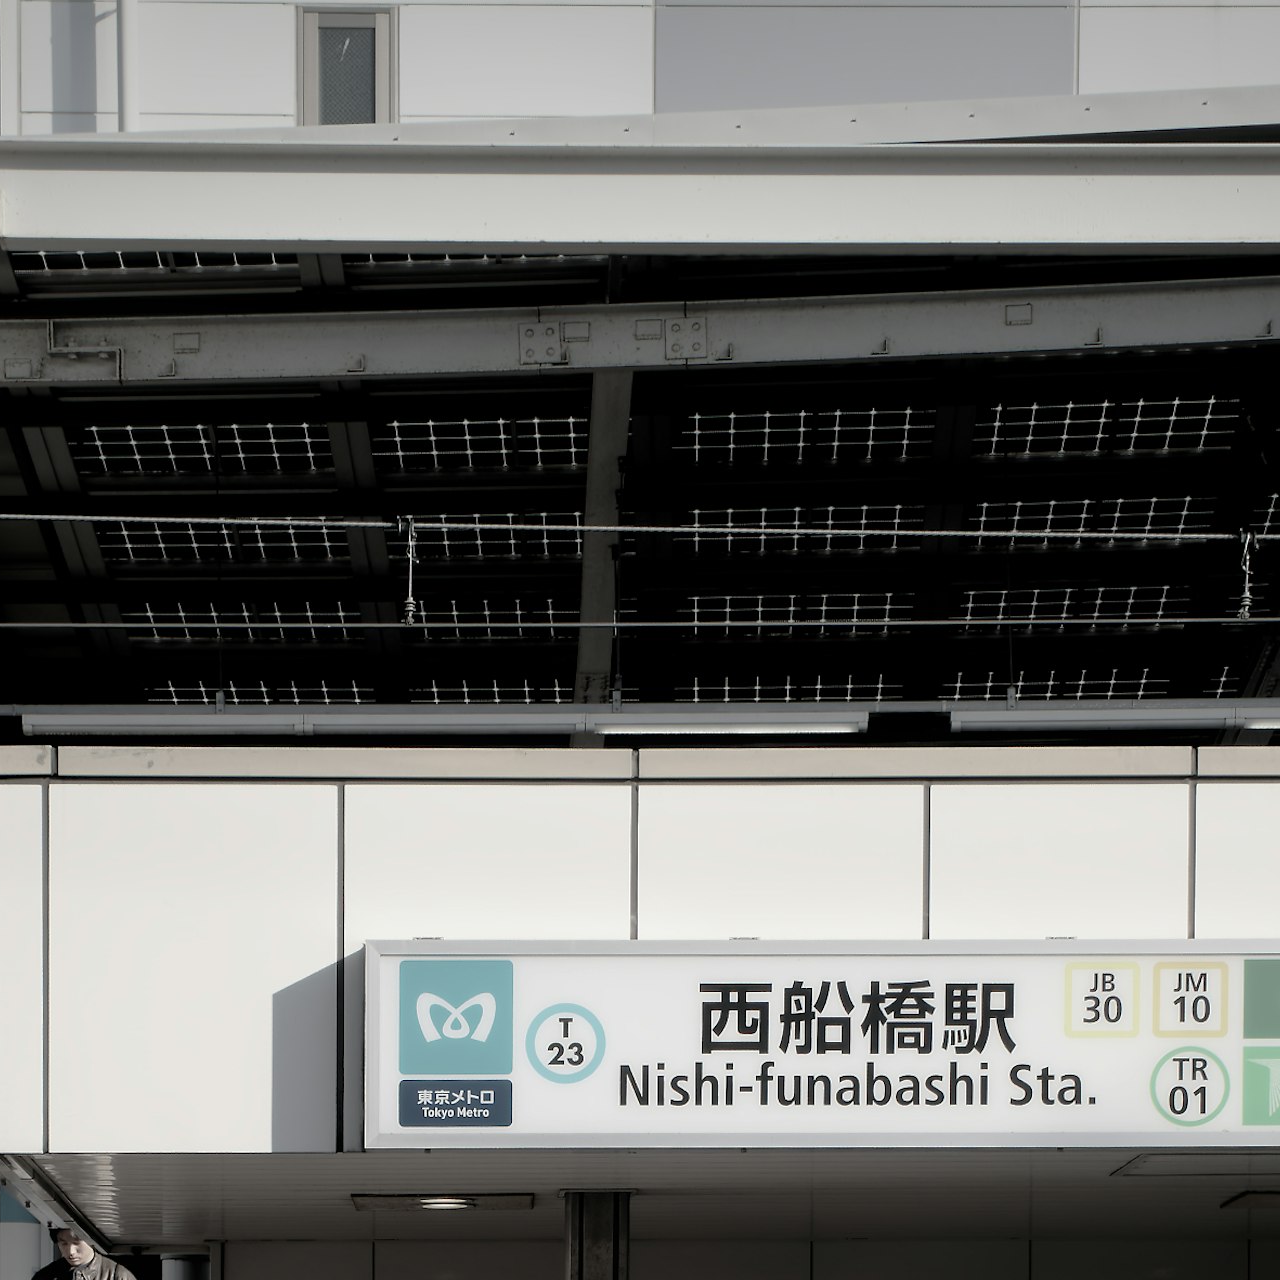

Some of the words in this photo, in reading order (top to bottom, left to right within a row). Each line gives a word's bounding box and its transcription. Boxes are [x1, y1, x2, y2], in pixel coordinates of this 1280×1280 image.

[1089, 973, 1116, 992] JB
[1173, 973, 1208, 992] JM
[699, 979, 1017, 1055] 西船橋駅
[1083, 996, 1122, 1023] 30
[1174, 996, 1211, 1023] 10
[558, 1018, 573, 1038] T
[548, 1042, 584, 1066] 23
[1172, 1058, 1209, 1081] TR
[619, 1062, 988, 1106] Nishi-funabashi
[1010, 1064, 1097, 1106] Sta.
[417, 1089, 495, 1105] 東京メトロ
[1169, 1086, 1209, 1115] 01
[422, 1107, 455, 1119] Tokyo
[457, 1107, 490, 1118] Metro
